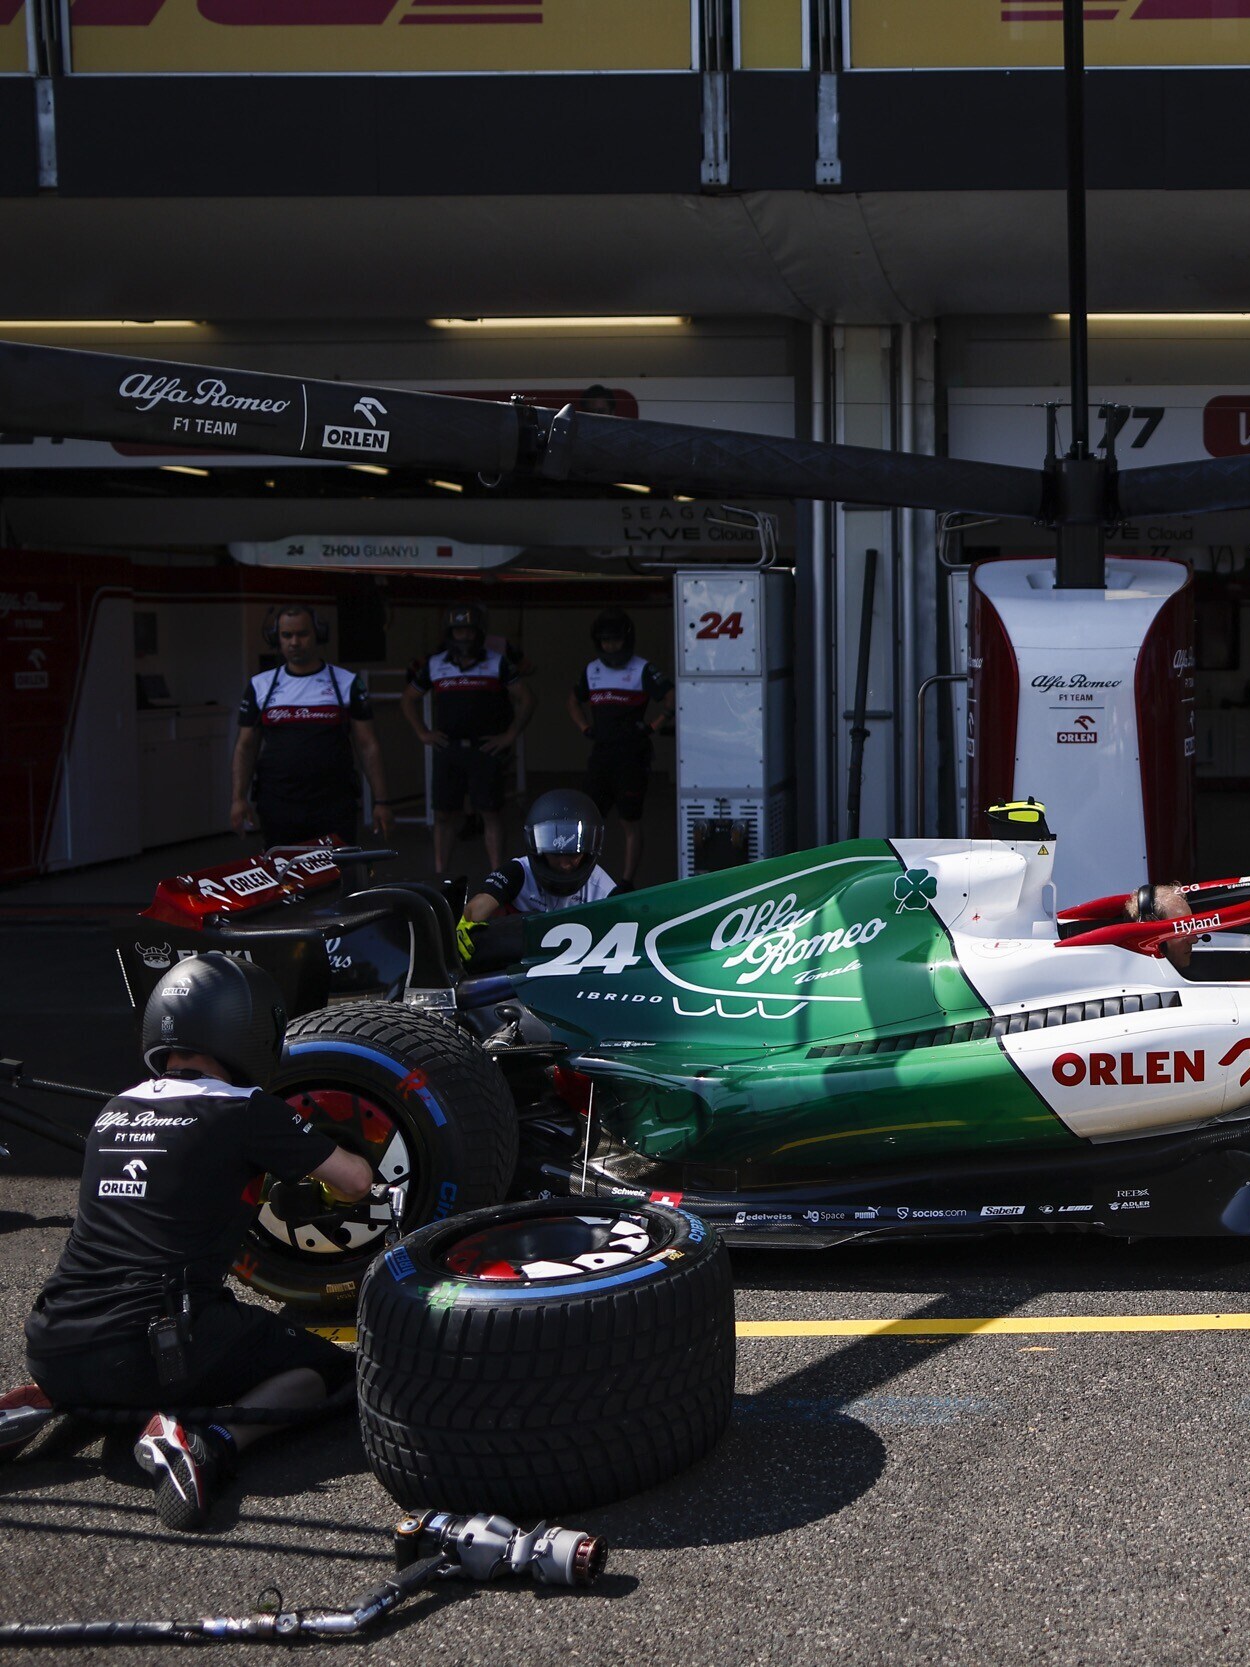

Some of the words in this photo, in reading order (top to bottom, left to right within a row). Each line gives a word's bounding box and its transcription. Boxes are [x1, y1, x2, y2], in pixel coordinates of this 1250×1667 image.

[119, 373, 193, 411] Alfa
[191, 379, 291, 413] Romeo
[172, 416, 189, 432] F1
[195, 419, 237, 436] TEAM
[1097, 407, 1165, 449] 77
[326, 428, 387, 450] ORLEN
[624, 527, 700, 540] LYVE
[1147, 526, 1193, 540] Cloud
[287, 545, 304, 557] 24
[322, 545, 359, 557] ZHOU
[363, 545, 420, 558] GUANYU
[696, 611, 743, 639] 24
[1030, 675, 1068, 693] Alfa
[1069, 674, 1122, 688] Romeo
[1058, 732, 1097, 742] ORLEN
[228, 868, 275, 894] ORLEN
[711, 893, 816, 953] Alfa
[1172, 914, 1221, 934] Hyland
[526, 922, 641, 977] 24
[722, 918, 887, 984] Romeo
[793, 959, 864, 985] Tonale
[162, 988, 188, 996] ORLEN
[576, 991, 662, 1003] IBRIDO
[1052, 1049, 1205, 1087] ORLEN
[95, 1112, 131, 1132] Alfa
[130, 1110, 198, 1127] Romeo
[115, 1132, 127, 1142] F1
[128, 1132, 155, 1142] TEAM
[100, 1181, 145, 1196] ORLEN
[611, 1187, 647, 1197] Schweiz
[746, 1212, 792, 1220] edelweiss
[855, 1211, 876, 1220] PUMA
[984, 1206, 1022, 1215] Sabelt
[1058, 1204, 1094, 1212] LEMO
